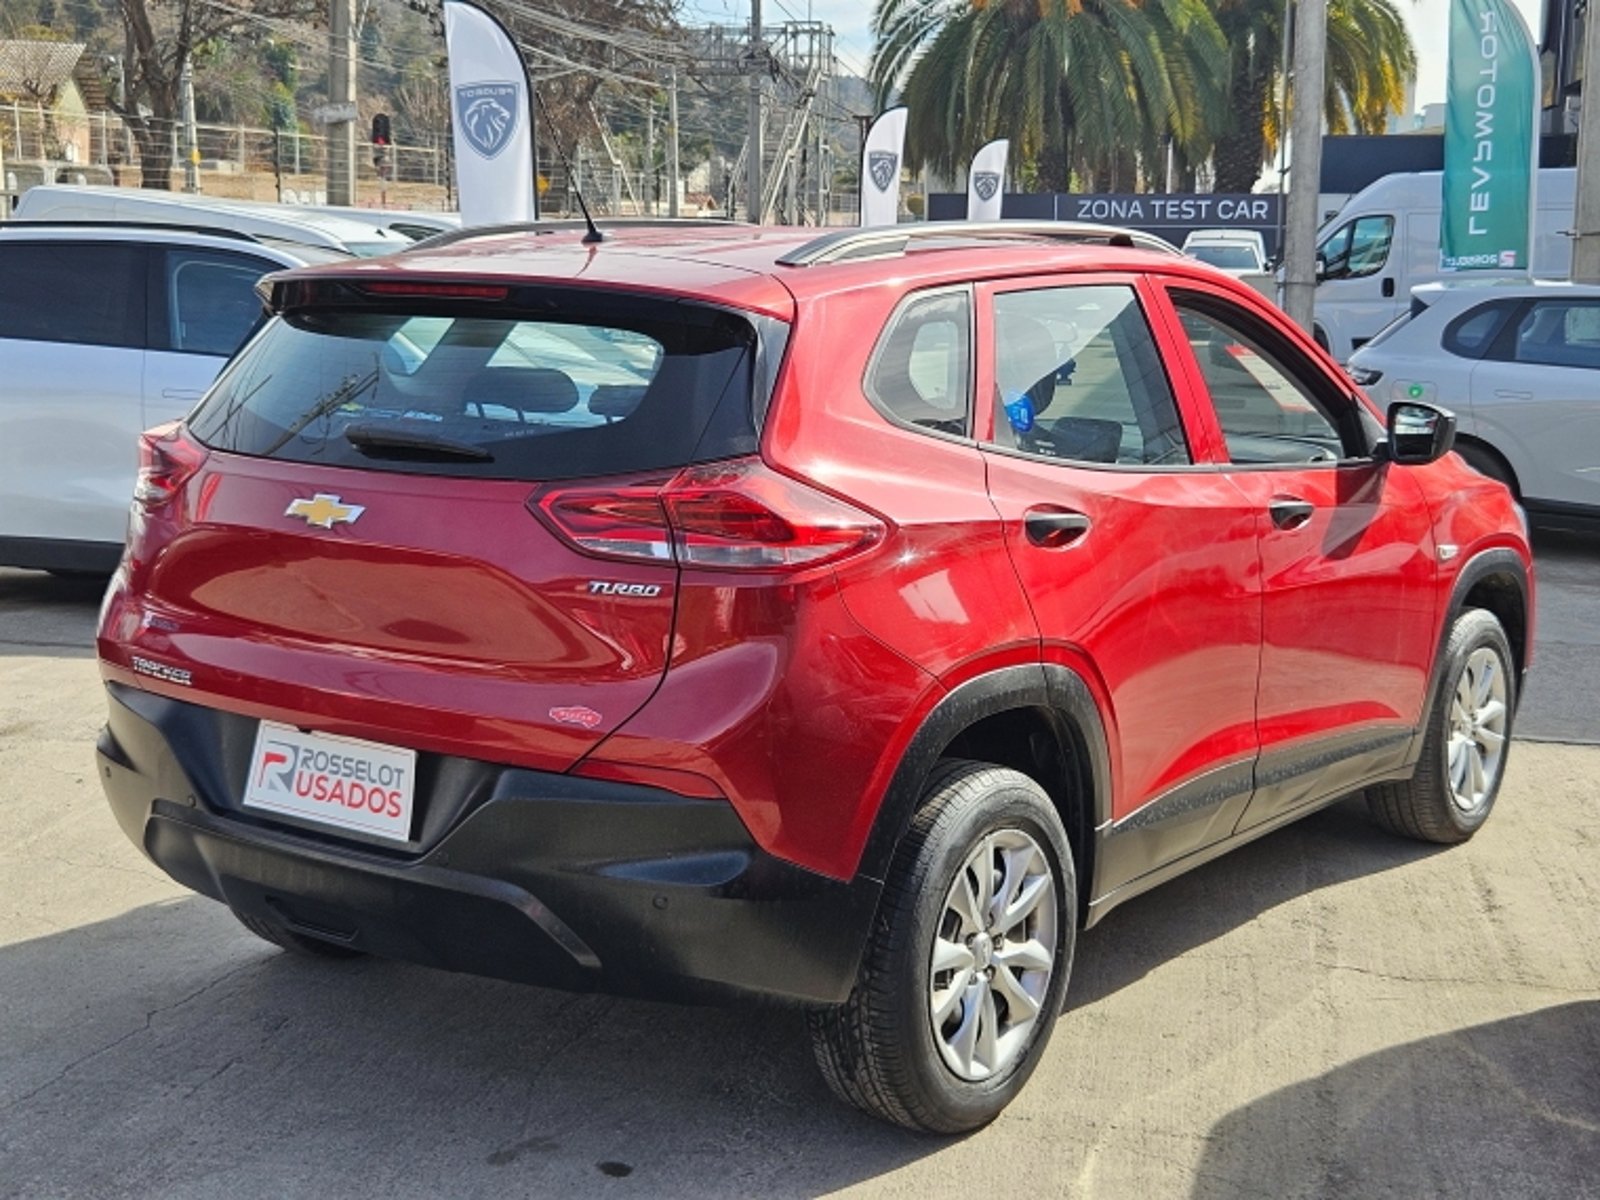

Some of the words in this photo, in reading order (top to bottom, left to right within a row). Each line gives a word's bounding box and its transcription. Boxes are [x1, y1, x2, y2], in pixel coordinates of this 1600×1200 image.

[1077, 200, 1144, 218] ZONA
[1150, 200, 1211, 219] TEST
[1217, 201, 1269, 220] CAR
[589, 581, 661, 597] TURBO
[301, 748, 405, 789] ROSSELOT
[296, 771, 402, 818] USADOS
